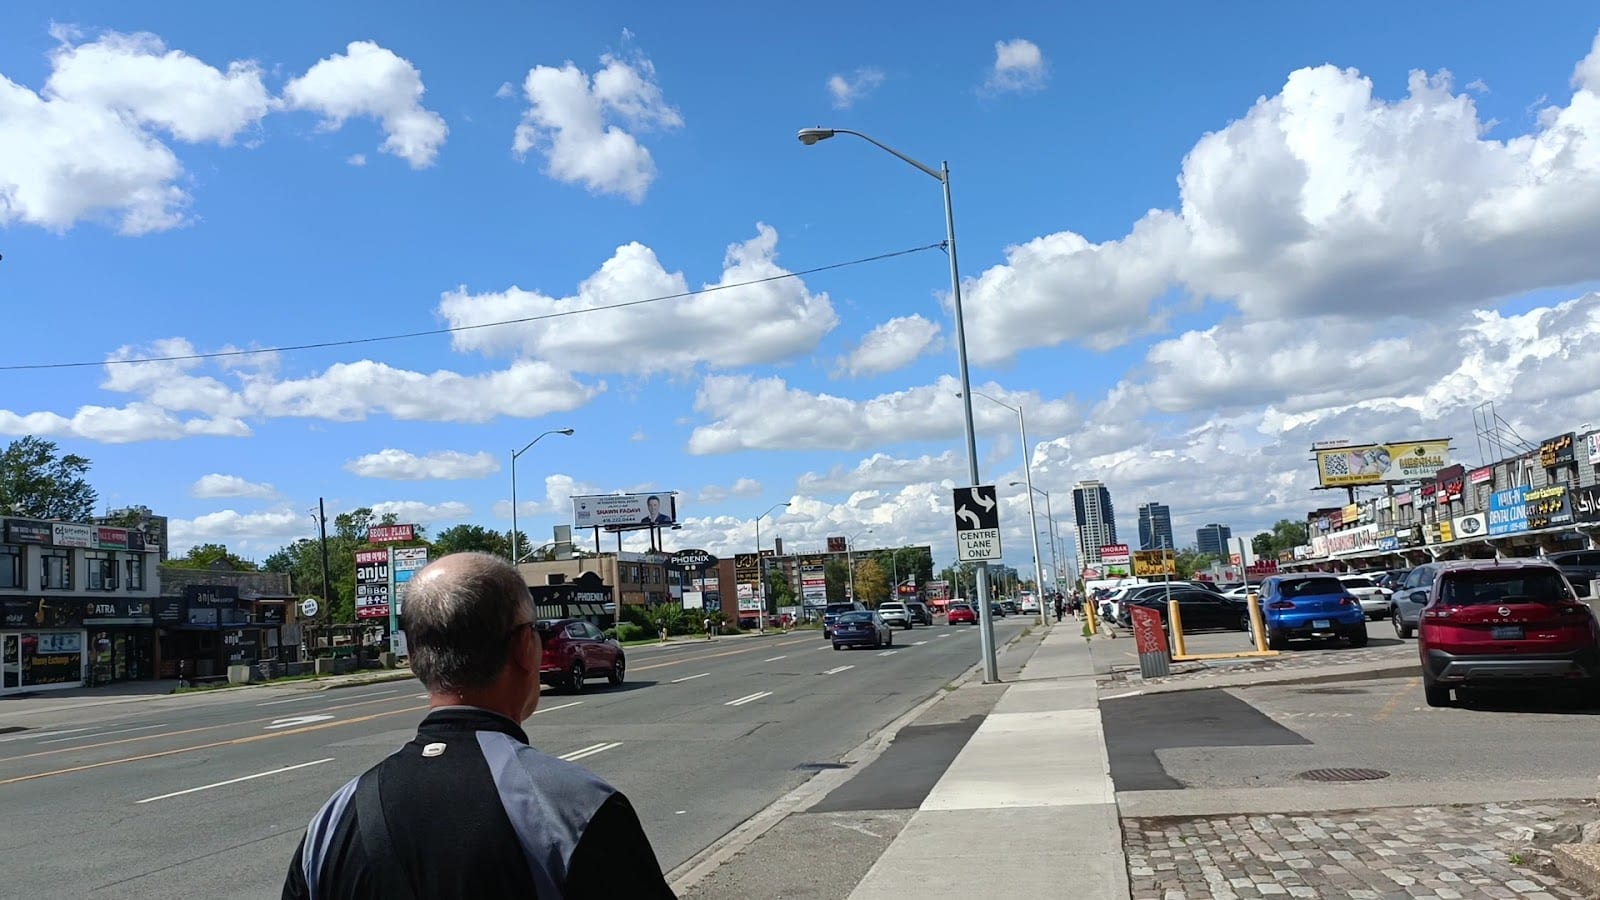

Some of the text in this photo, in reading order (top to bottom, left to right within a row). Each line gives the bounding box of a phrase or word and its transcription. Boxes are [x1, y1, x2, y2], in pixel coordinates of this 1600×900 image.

[1489, 508, 1510, 525] DENTAL
[1509, 504, 1527, 521] CLINIC
[370, 525, 410, 538] SEOUL PLAZA
[960, 530, 997, 541] CENTRE
[967, 540, 992, 549] LANE
[1101, 545, 1128, 553] KHORAK
[968, 549, 991, 558] ONLY
[671, 555, 709, 564] PHOENIX
[357, 563, 387, 582] anju
[367, 587, 388, 595] BBQ
[577, 592, 604, 601] PHOENIX
[197, 590, 215, 606] anju
[95, 604, 116, 615] ATRA
[224, 632, 239, 647] anju
